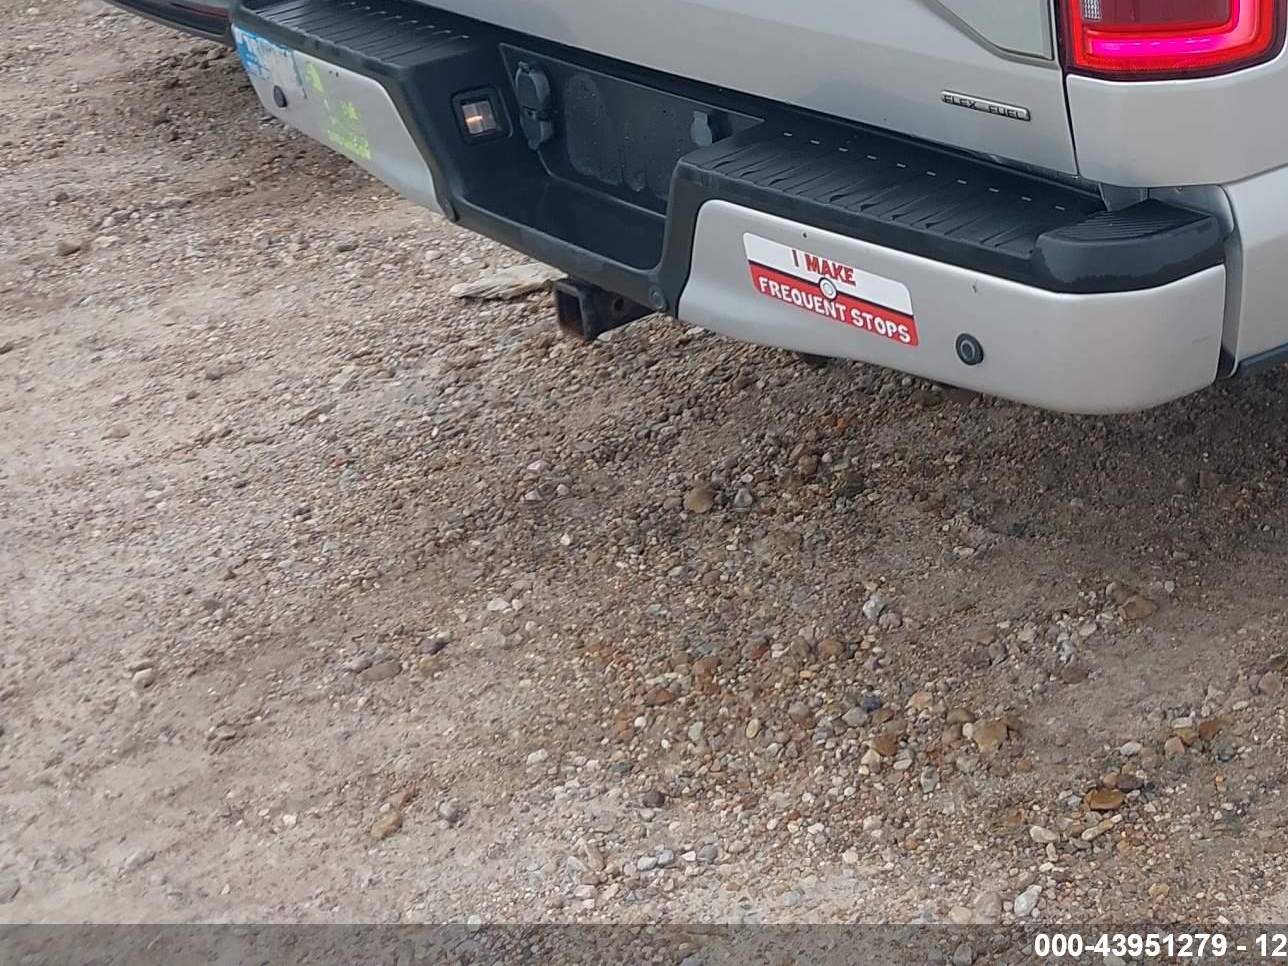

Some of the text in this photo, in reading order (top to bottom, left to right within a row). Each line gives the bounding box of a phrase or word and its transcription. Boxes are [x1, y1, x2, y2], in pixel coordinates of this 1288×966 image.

[943, 93, 1026, 121] FLEX FUEL
[791, 249, 857, 287] I MAKE
[759, 277, 912, 344] FREQUENT STOPS
